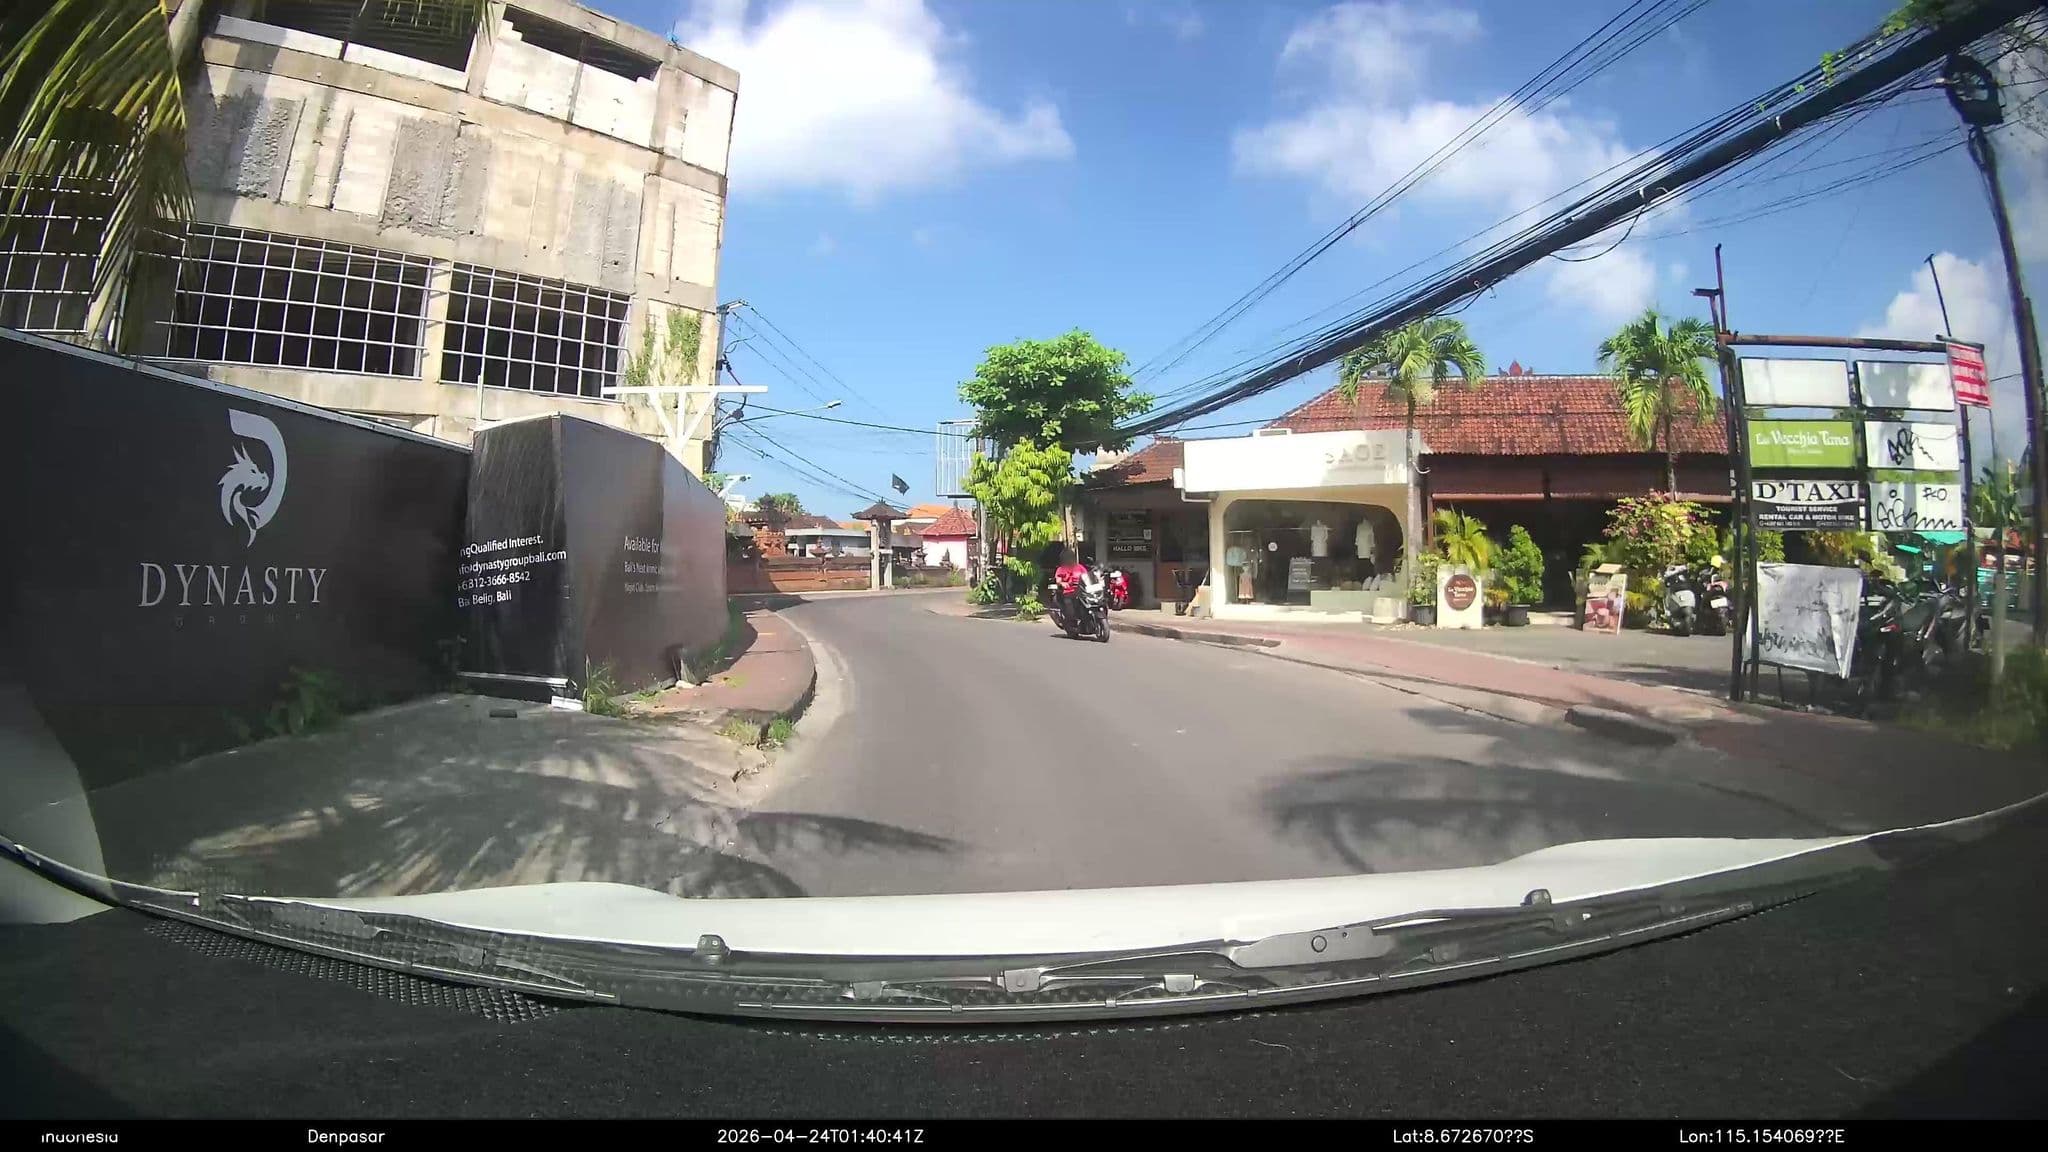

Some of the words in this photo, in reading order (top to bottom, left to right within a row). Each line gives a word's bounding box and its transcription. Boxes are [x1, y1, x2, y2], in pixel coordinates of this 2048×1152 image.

[1755, 481, 1856, 502] D'TAXI
[1776, 505, 1807, 513] TOURIST
[138, 562, 327, 607] DYNASTY
[496, 590, 512, 603] Bali
